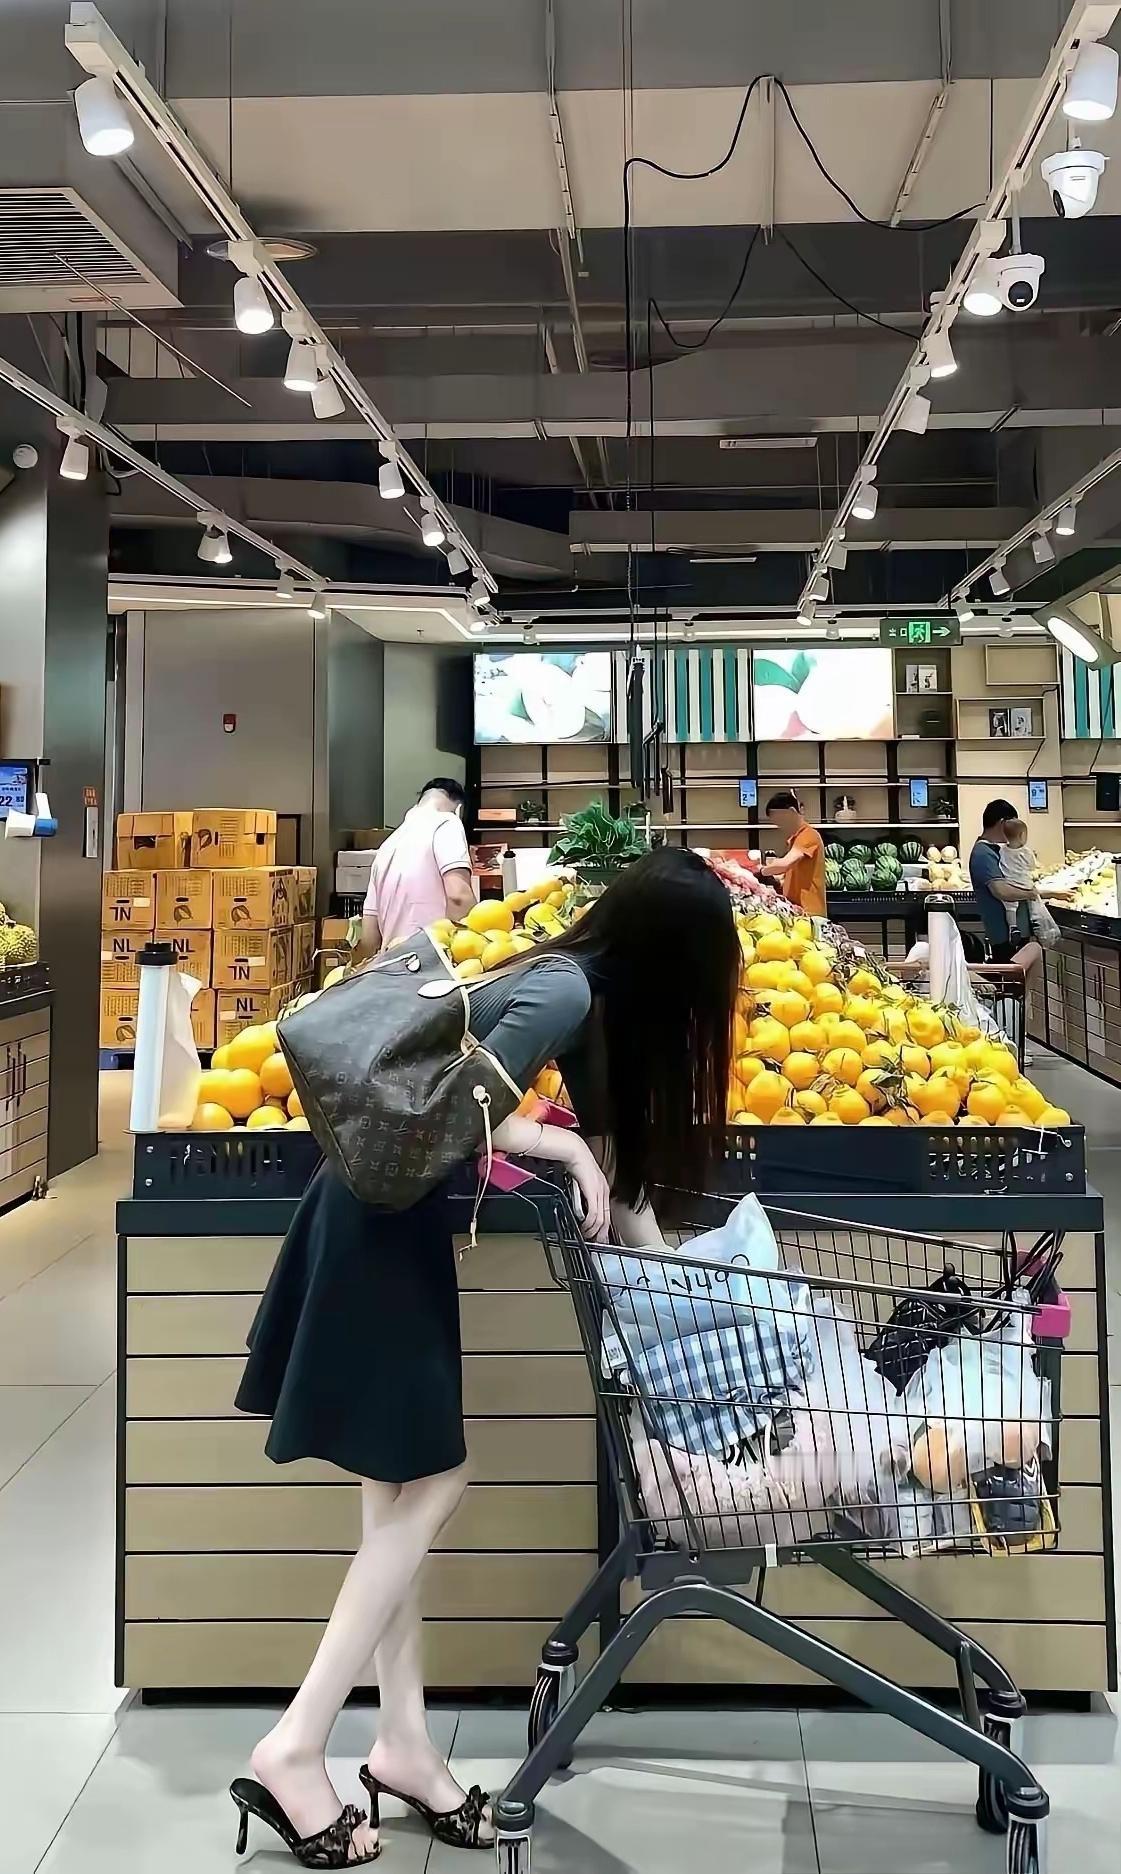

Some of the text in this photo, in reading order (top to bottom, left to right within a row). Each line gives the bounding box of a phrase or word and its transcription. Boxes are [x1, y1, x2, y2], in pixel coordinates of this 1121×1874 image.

[113, 938, 136, 953] NL
[172, 938, 195, 953] NL
[236, 998, 260, 1011] NL
